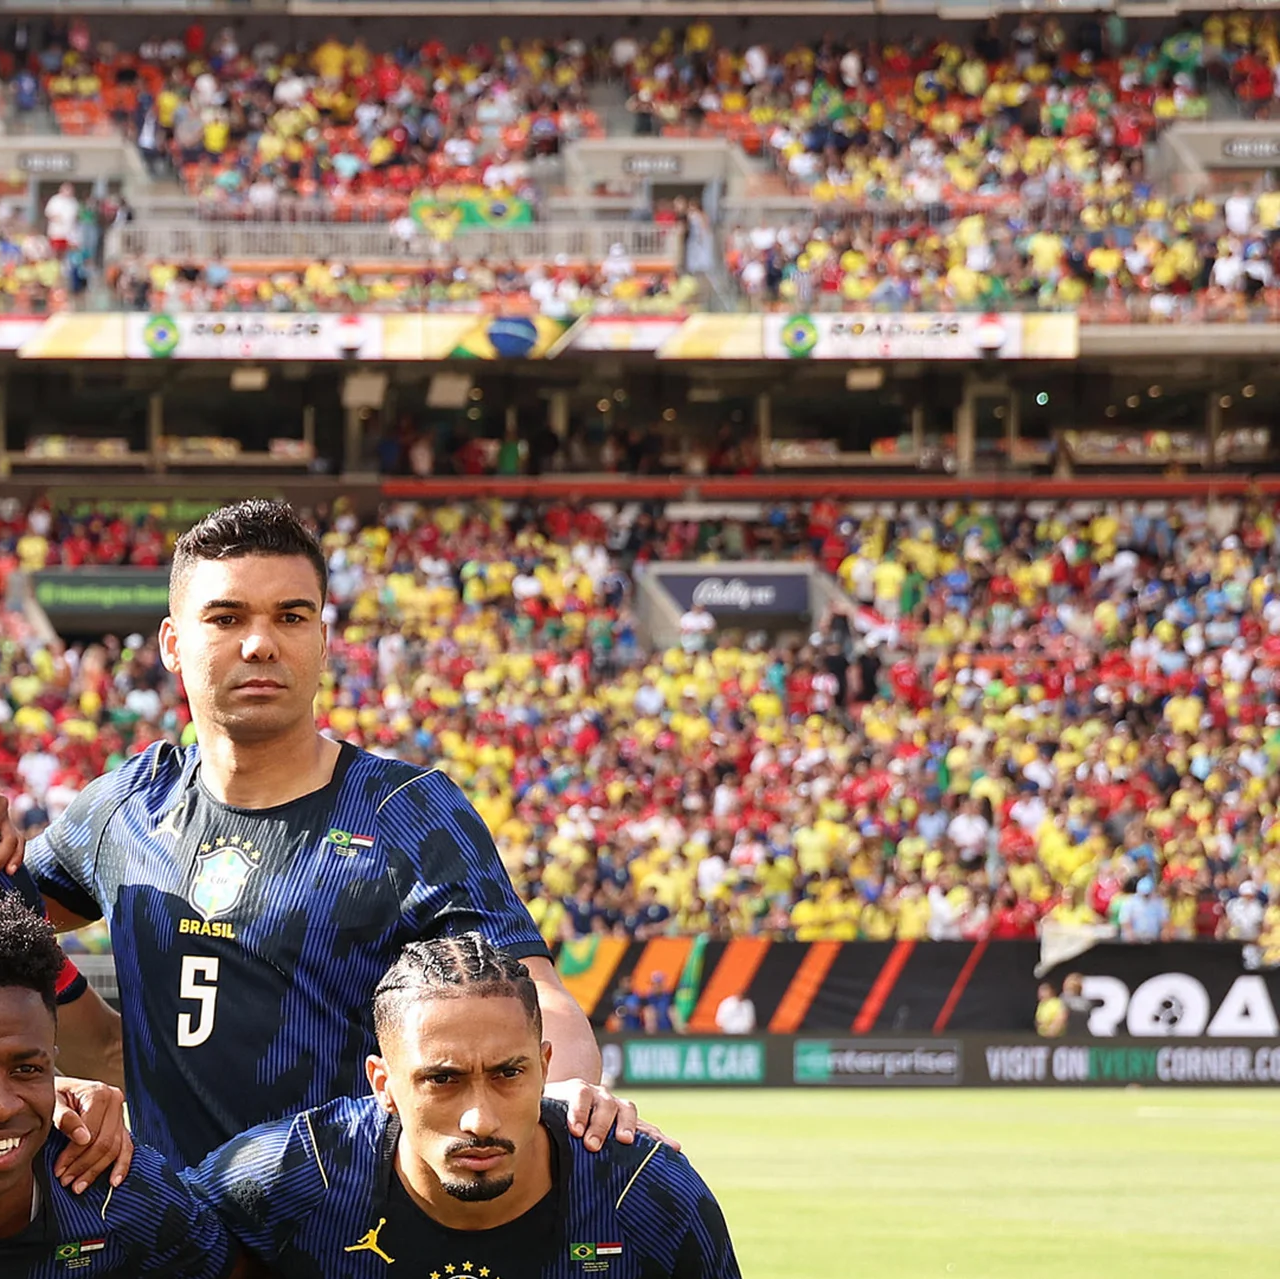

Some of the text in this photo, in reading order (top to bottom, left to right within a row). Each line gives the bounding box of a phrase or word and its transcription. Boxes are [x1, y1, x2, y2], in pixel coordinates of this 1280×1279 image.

[179, 919, 236, 939] BRASIL
[177, 955, 220, 1048] 5
[628, 1043, 679, 1080] WIN
[682, 1043, 703, 1080] A
[707, 1043, 762, 1080] CAR
[985, 1046, 1050, 1081] VISIT
